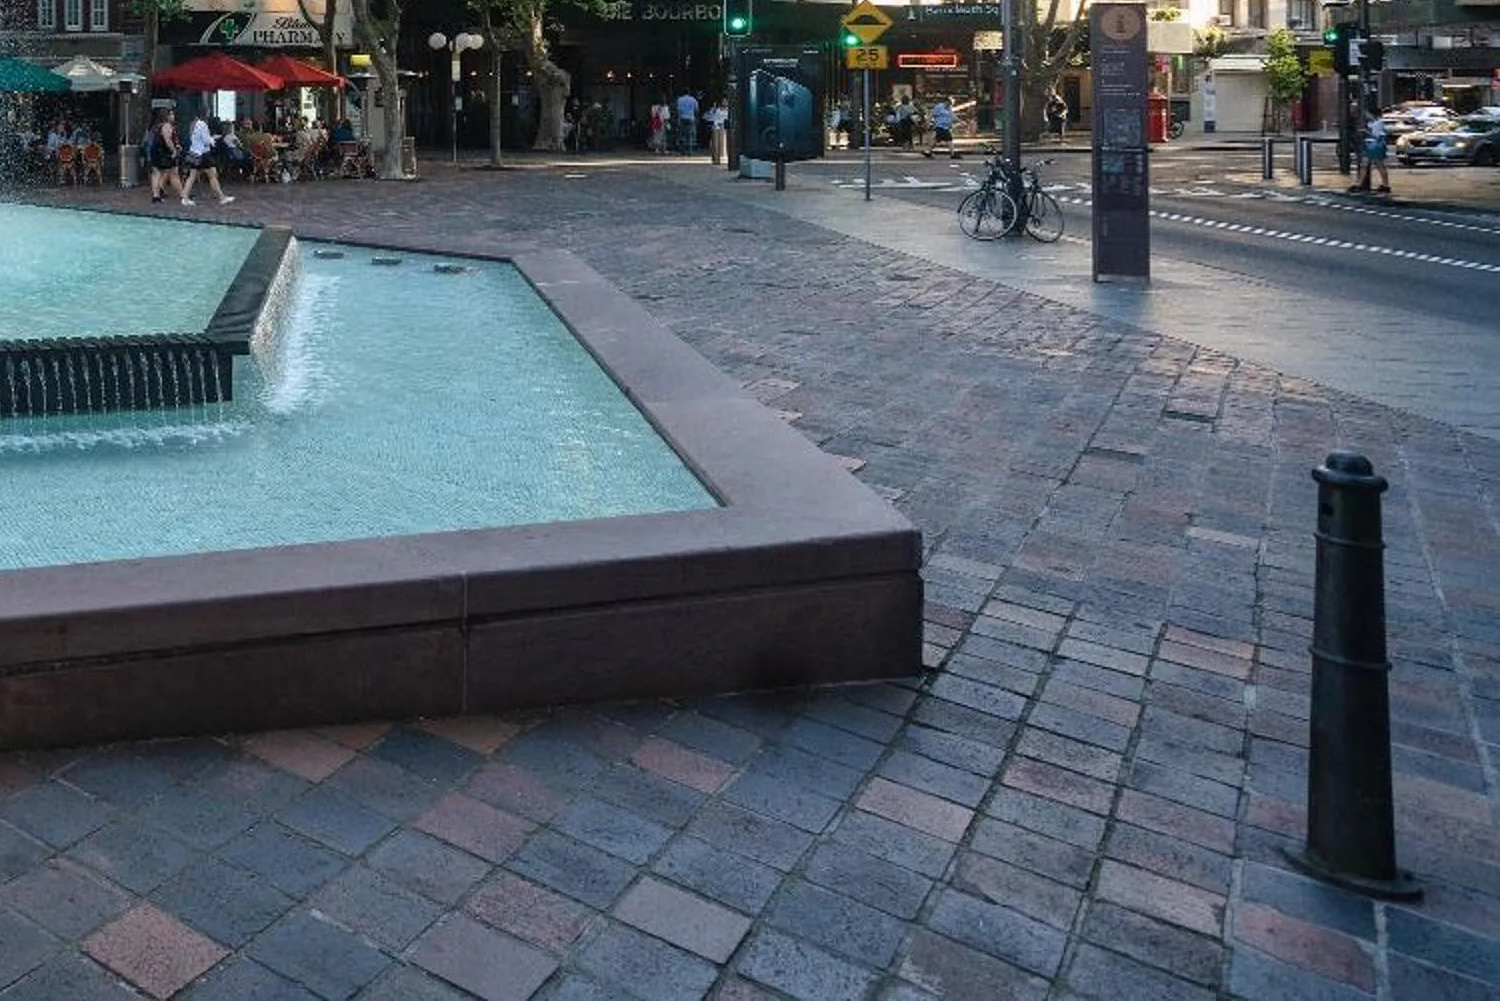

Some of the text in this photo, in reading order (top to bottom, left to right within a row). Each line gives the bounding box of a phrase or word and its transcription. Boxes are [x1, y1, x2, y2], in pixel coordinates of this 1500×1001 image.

[642, 3, 722, 20] BOURBO
[253, 29, 346, 44] PHARMY
[856, 48, 879, 62] 25
